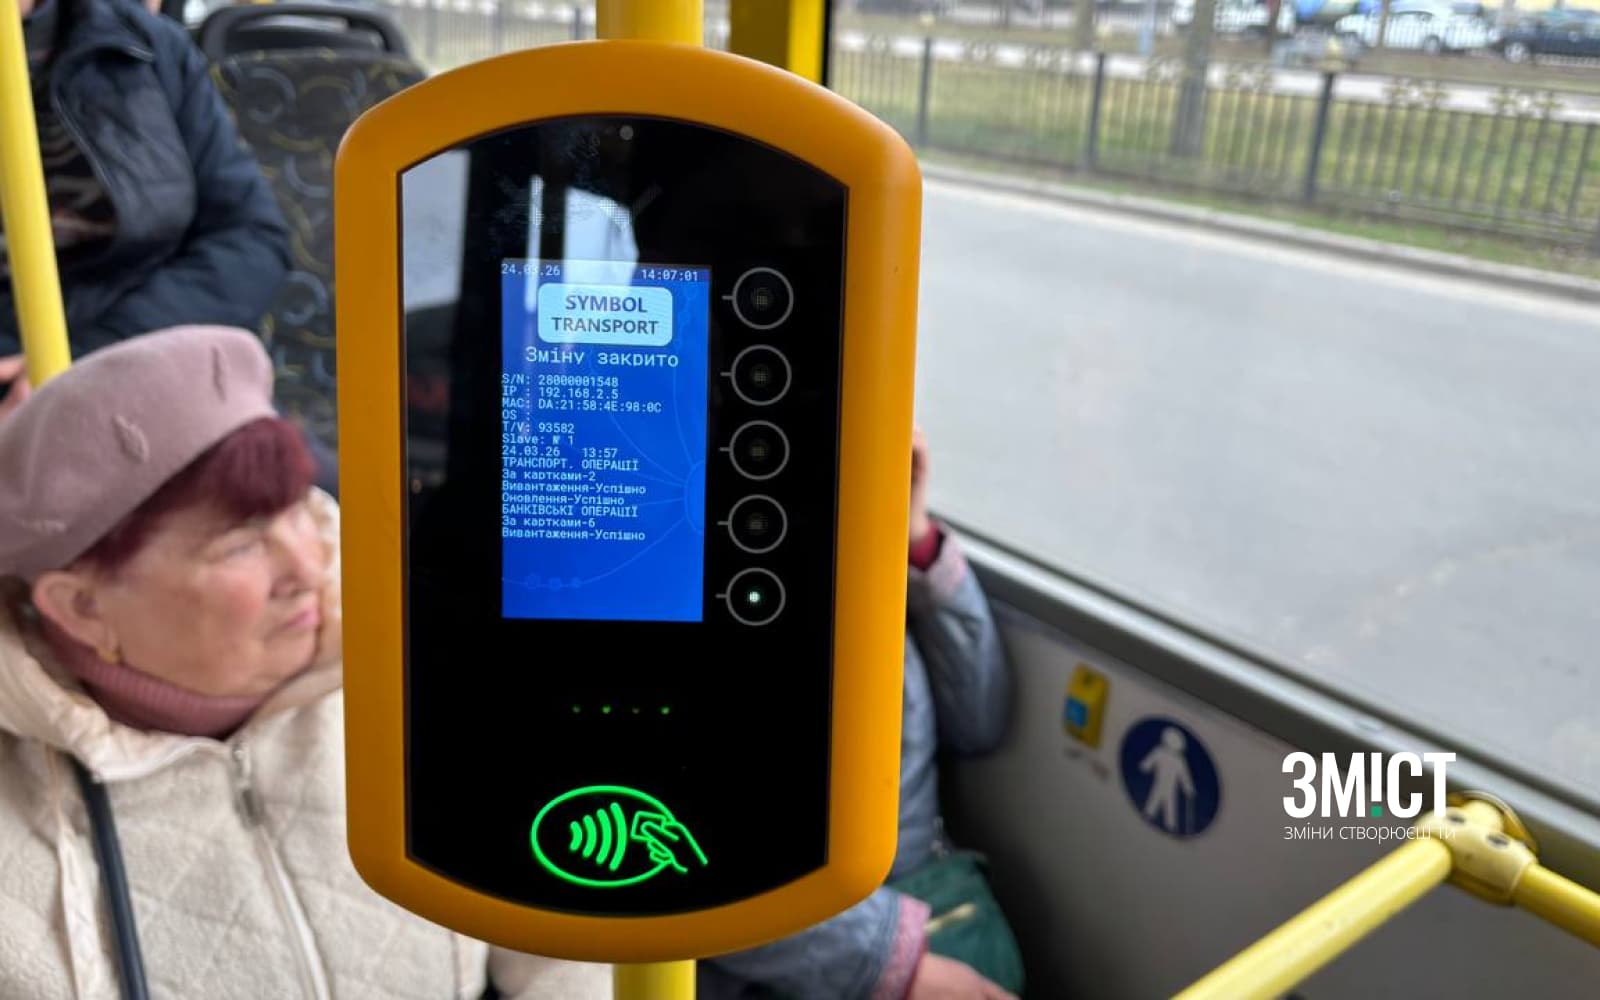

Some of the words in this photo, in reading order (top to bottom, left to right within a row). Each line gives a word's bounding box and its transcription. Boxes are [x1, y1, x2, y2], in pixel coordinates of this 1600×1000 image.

[642, 269, 699, 281] 14:07:01
[566, 295, 647, 313] SYMBOL
[552, 317, 659, 335] TRANSPORT
[525, 347, 585, 365] Зміну
[598, 352, 679, 367] закрито
[502, 374, 531, 385] S/N:
[539, 387, 619, 399] 192.168.2.5
[502, 398, 531, 409] MAC:
[502, 421, 531, 433] T/V:
[538, 423, 575, 434] 93582
[502, 433, 545, 444] Slave:
[568, 436, 574, 445] 1
[502, 445, 560, 457] 24.03.26
[582, 448, 618, 458] 13:57
[502, 457, 574, 469] ТРАНСПОРТ.
[582, 459, 639, 471] ОПЕРАЦІЇ
[502, 469, 516, 479] За
[524, 471, 596, 482] картками-2
[502, 481, 646, 494] Вивантаження-Успішно
[502, 493, 624, 505] Оновлення-Успішно
[502, 504, 573, 516] БАНКІВСЬКІ
[582, 506, 638, 517] ОПЕРАЦІЇ
[502, 516, 516, 526] За
[524, 517, 595, 528] картками-6
[502, 527, 646, 541] Вивантаження-Успішно
